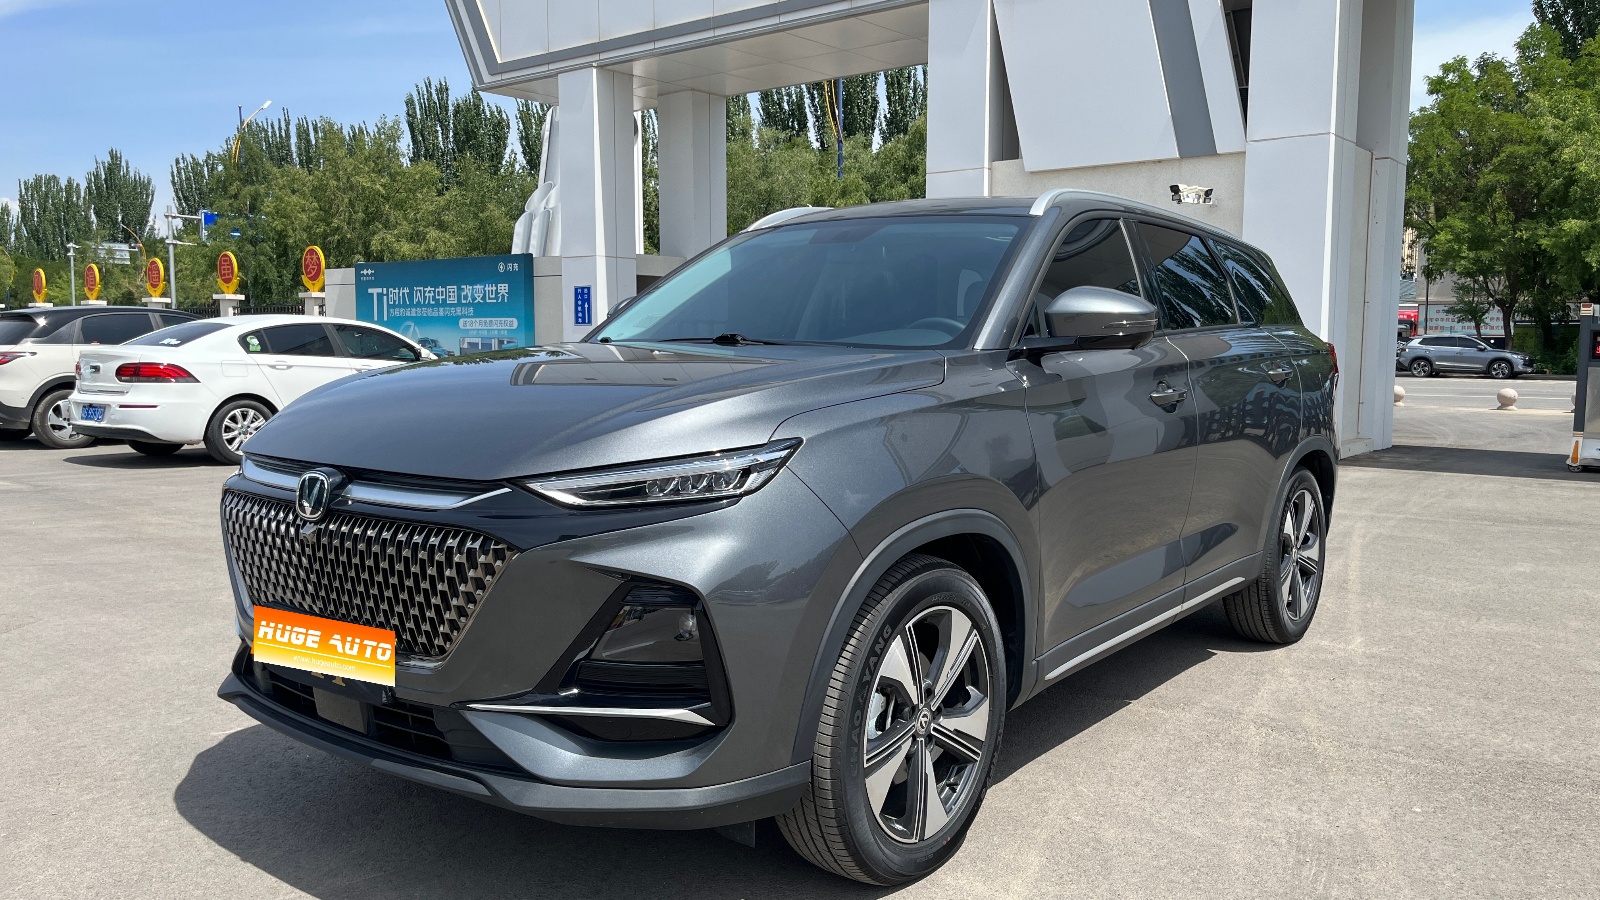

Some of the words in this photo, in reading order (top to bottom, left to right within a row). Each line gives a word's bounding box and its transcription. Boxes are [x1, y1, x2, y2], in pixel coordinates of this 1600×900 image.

[221, 256, 234, 279] 虽
[305, 252, 320, 278] 梦
[413, 285, 458, 304] 闪充中国
[461, 283, 509, 303] 改变世界
[862, 623, 892, 683] YANG
